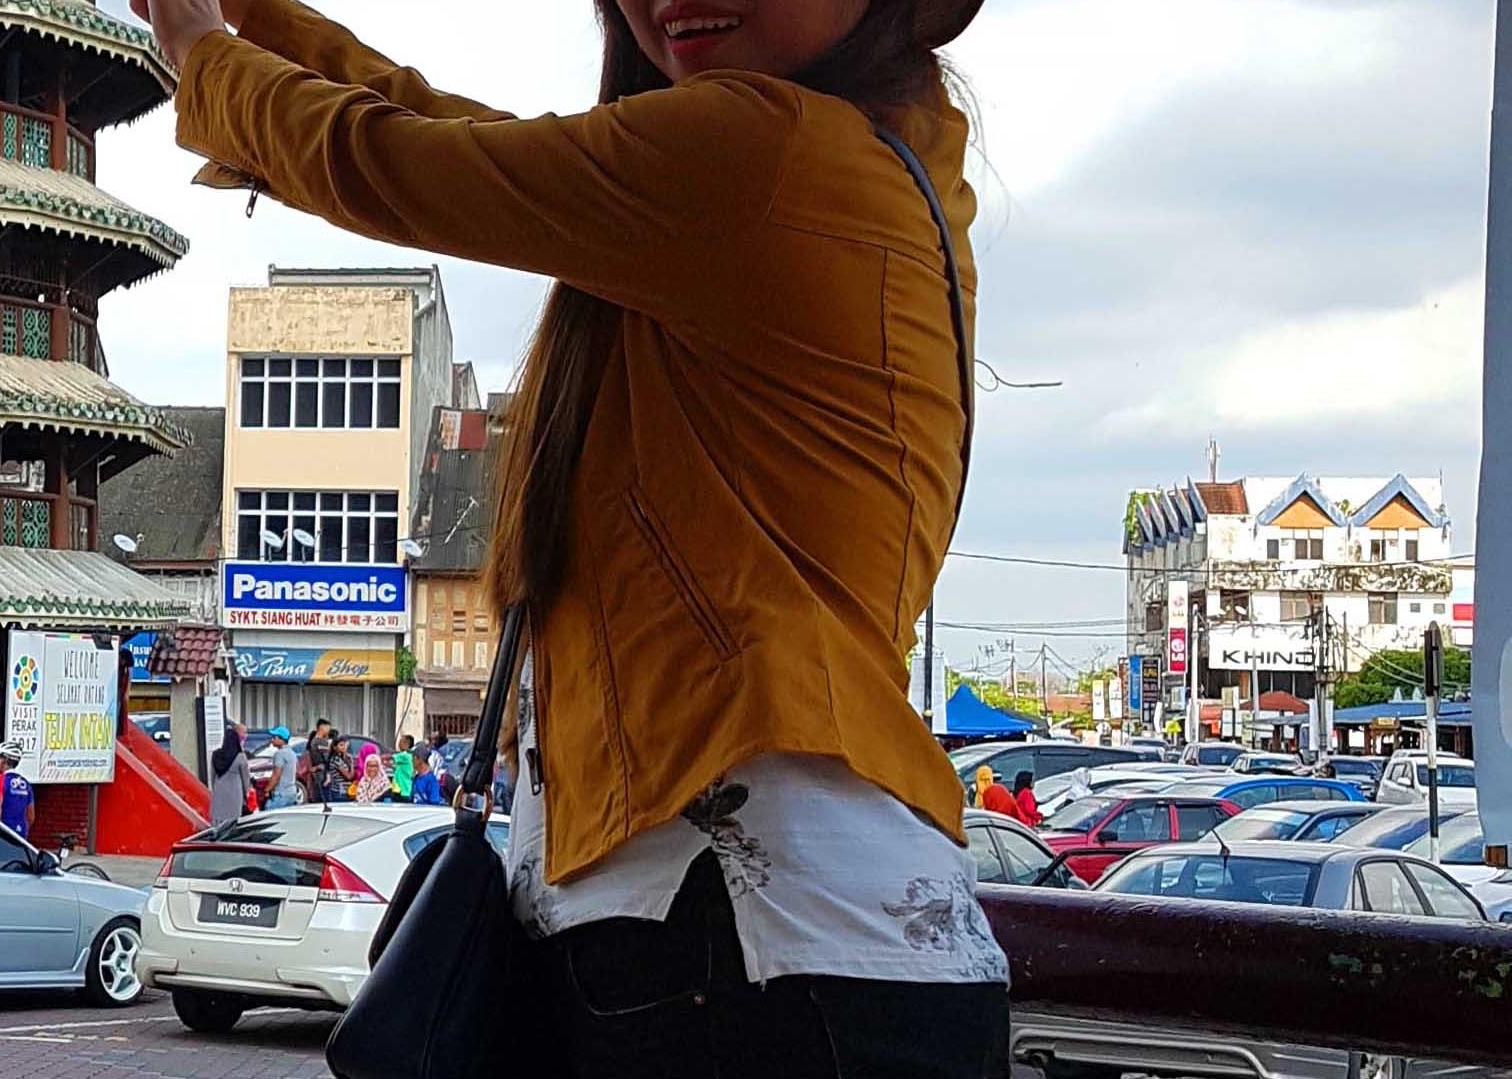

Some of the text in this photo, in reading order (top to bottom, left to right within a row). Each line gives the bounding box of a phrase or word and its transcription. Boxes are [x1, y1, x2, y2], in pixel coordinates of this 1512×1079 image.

[232, 574, 397, 603] Panasonic
[230, 611, 258, 625] SYKT.
[262, 612, 292, 626] SIANG
[295, 613, 322, 626] HUAT
[64, 650, 99, 679] WELCOME
[261, 657, 369, 679] Pana Shop
[12, 707, 38, 719] VISIT
[11, 719, 37, 731] PERAK
[45, 712, 114, 750] TELUK INTAN
[217, 902, 260, 918] WVC 939
